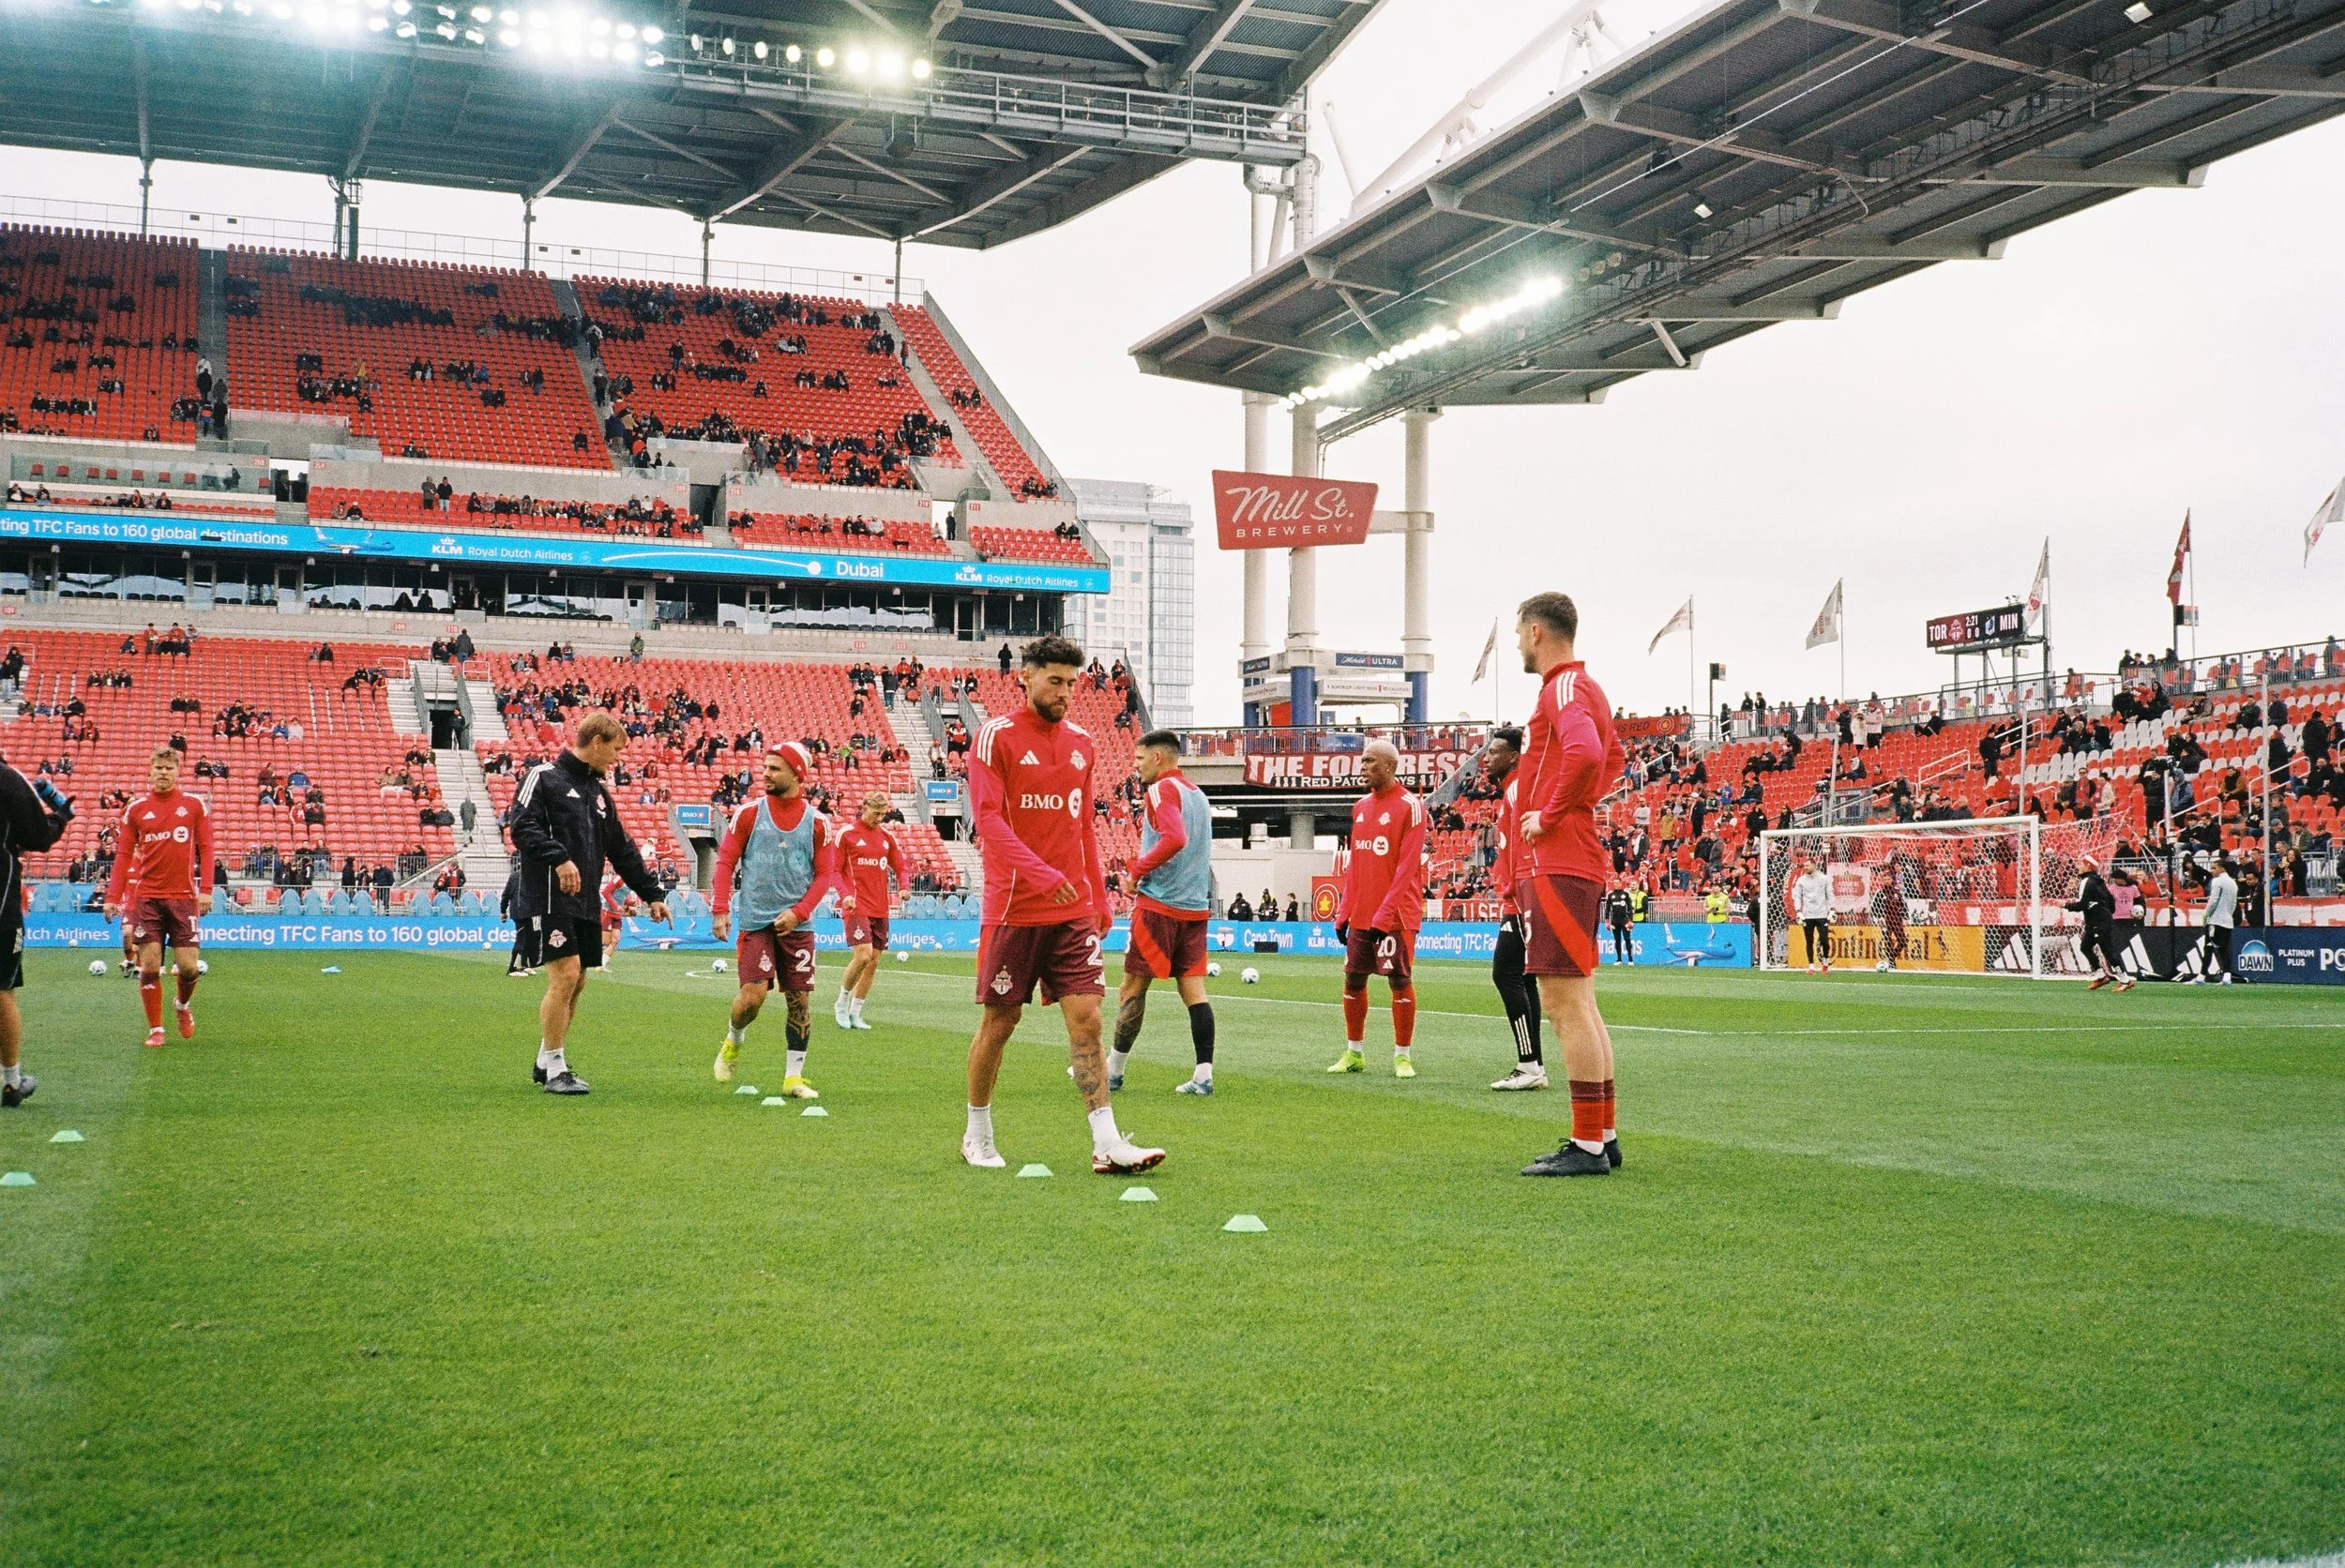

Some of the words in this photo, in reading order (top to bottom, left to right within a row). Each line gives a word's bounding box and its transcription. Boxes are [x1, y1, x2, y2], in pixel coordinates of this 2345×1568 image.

[1225, 486, 1309, 523] Mill
[1310, 487, 1354, 520] St.
[0, 518, 29, 535] ting
[33, 519, 62, 534] TFC
[66, 521, 99, 535] Fans
[103, 523, 118, 536] to
[122, 524, 147, 537] 160
[151, 526, 197, 541] global
[201, 528, 288, 545] destinations
[1236, 523, 1342, 538] BREWERY
[432, 544, 462, 555] KLM
[469, 547, 497, 558] Royal
[501, 548, 531, 558] Dutch
[535, 550, 573, 561] Airlines
[837, 561, 884, 578] Dubai
[955, 572, 982, 582] KLM
[987, 575, 1010, 586] Royal
[1015, 575, 1041, 585] Dutch
[1045, 577, 1078, 587] Airlines
[2000, 613, 2019, 631] MIN
[1929, 625, 1947, 641] TOR
[1629, 721, 1650, 731] RED
[1248, 754, 1304, 784] THE
[1312, 752, 1471, 779] FORES
[1275, 776, 1296, 787] 111
[1300, 776, 1330, 788] RED
[1332, 776, 1367, 787] PATC
[1020, 793, 1064, 810] BMO
[144, 831, 172, 843] BMO
[857, 857, 879, 867] BMO
[26, 927, 50, 940] tch
[55, 927, 110, 941] Airlines
[198, 925, 275, 945] nnecting
[280, 926, 316, 942] TFC
[321, 927, 363, 942] Fans
[368, 927, 386, 942] to
[391, 927, 422, 942] 160
[427, 927, 483, 946] global
[890, 933, 936, 944] Airlines
[1268, 929, 1294, 948] Town
[1308, 937, 1325, 948] KLM
[1464, 933, 1482, 950] TFC
[1483, 934, 1498, 950] Fan
[1085, 934, 1103, 966] 2
[2278, 949, 2315, 957] PLATINUM
[795, 949, 811, 972] 2
[2238, 955, 2274, 972] DAWN
